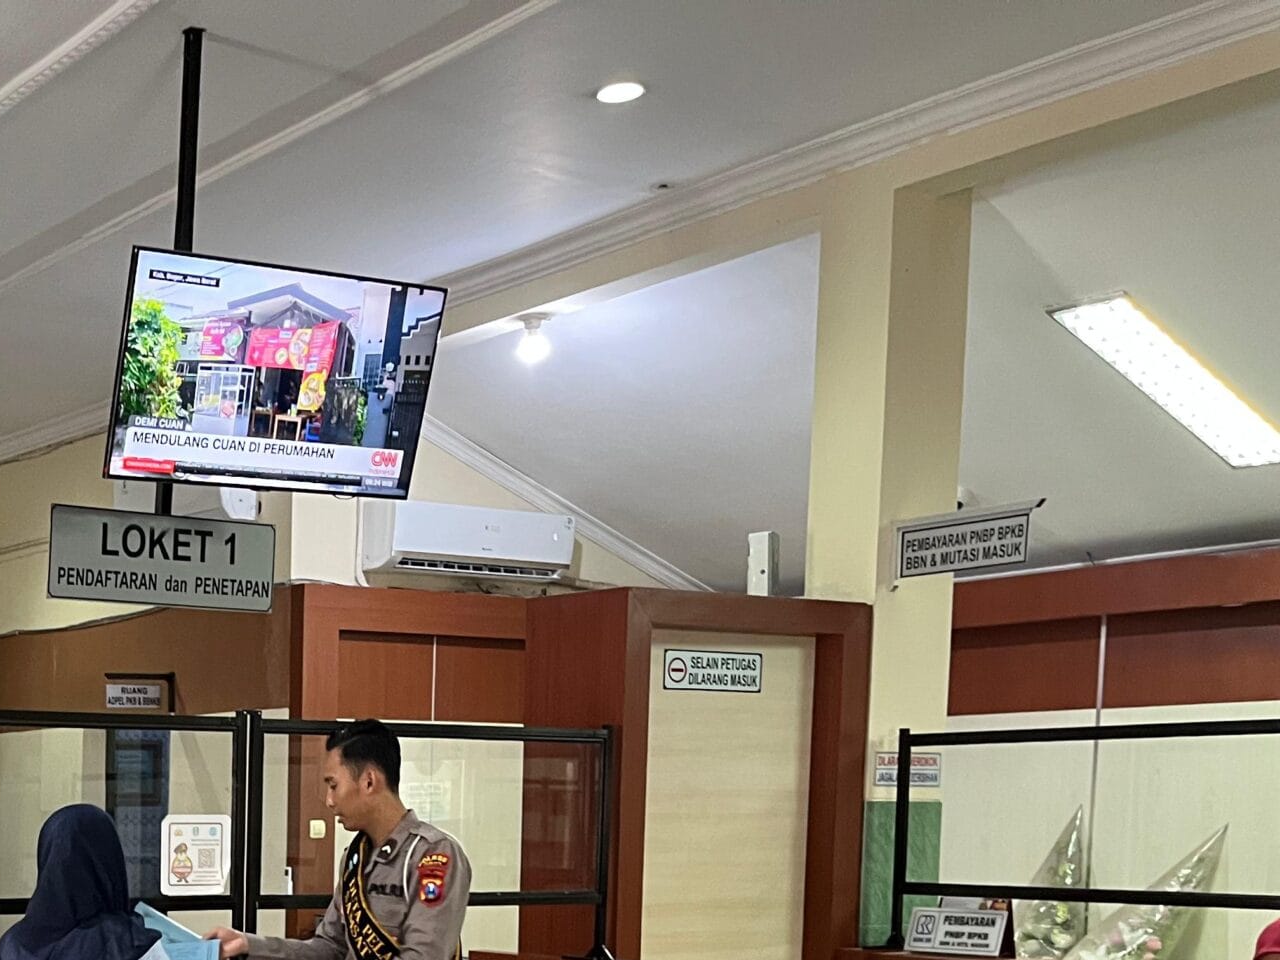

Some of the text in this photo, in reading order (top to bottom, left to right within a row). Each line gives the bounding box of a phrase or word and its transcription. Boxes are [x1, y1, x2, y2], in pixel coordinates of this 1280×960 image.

[134, 416, 184, 430] DEMI CUAN
[133, 431, 335, 459] MENDULANG CUAN DI PERUMAHAN
[371, 450, 399, 468] CNN
[101, 522, 236, 565] LOKET 1
[905, 523, 1024, 553] PEMBAYARAN PNBP BPKB
[905, 542, 1022, 570] BBN & MUTASI MASUK
[57, 566, 269, 599] PENDAFTARAN dan PENETAPAN
[690, 656, 757, 671] SELAIN PETUGAS
[688, 673, 757, 687] DILARANG MASUK
[943, 915, 997, 928] PEMBAYARAN
